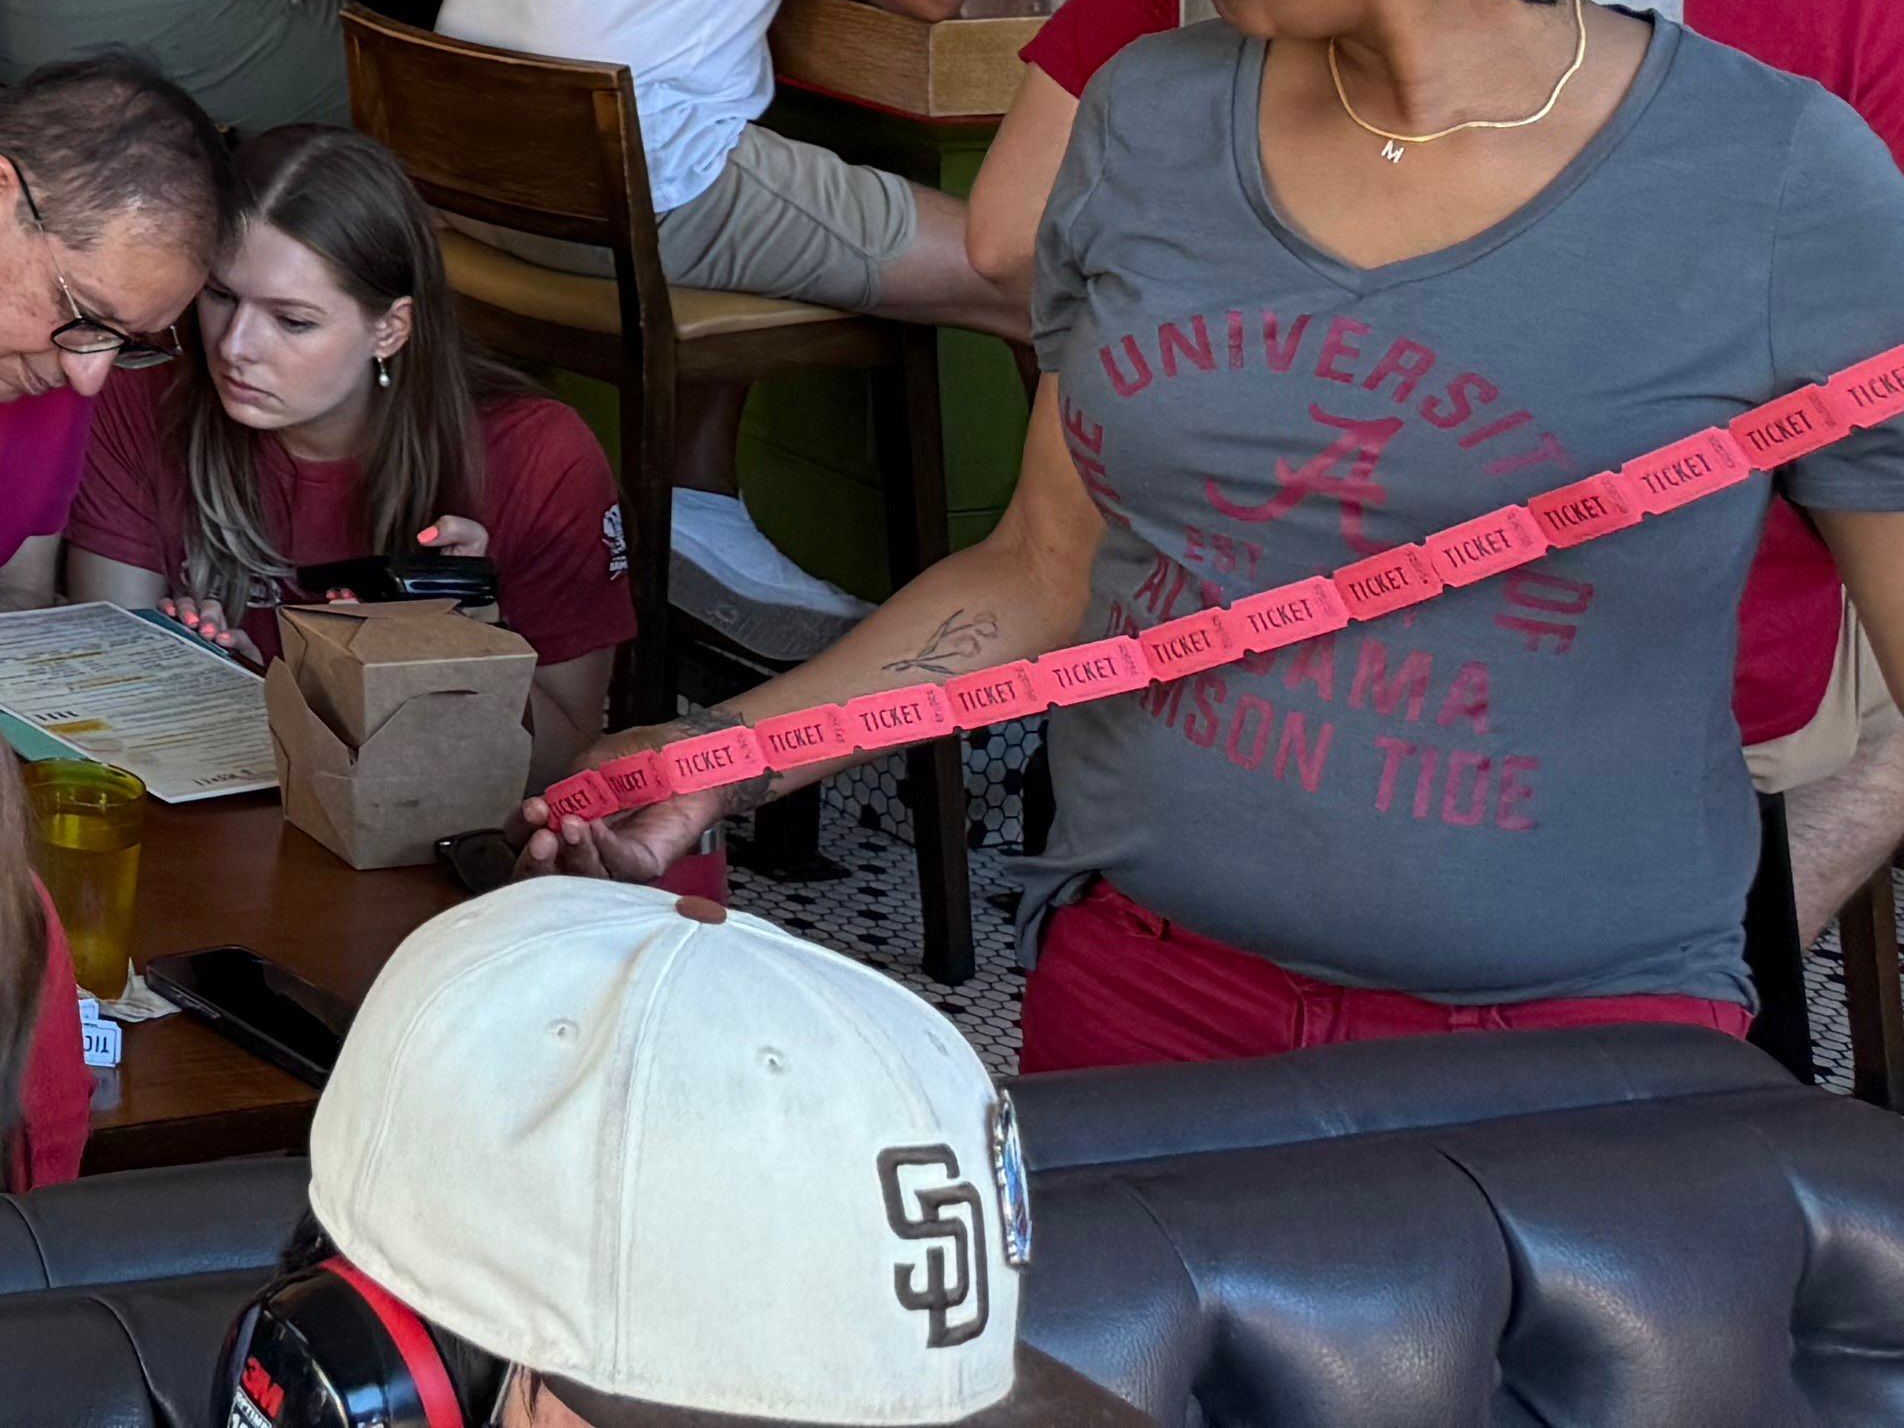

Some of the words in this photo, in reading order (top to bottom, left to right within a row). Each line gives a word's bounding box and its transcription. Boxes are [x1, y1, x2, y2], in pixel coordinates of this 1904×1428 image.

[1099, 310, 1578, 478] UNIVERSIT
[1847, 364, 1904, 408] TICKE
[1745, 409, 1814, 453] TICKET
[1641, 453, 1713, 495] TICKET
[1544, 495, 1608, 531] TICKET
[1443, 528, 1512, 569] TICKET
[1349, 565, 1410, 602] TICKET
[1247, 598, 1314, 634] TICKET
[1493, 570, 1594, 656] OF
[1133, 551, 1493, 735] ALAMA
[1151, 629, 1212, 664] TICKET
[1052, 657, 1120, 689] TICKET
[958, 679, 1017, 711] TICKET
[859, 702, 924, 733] TICKET
[768, 723, 826, 754] TICKET
[674, 745, 734, 777] TICKET
[1373, 734, 1542, 833] TIDE
[84, 1035, 110, 1053] TIC
[875, 1143, 990, 1349] SD
[242, 1355, 285, 1420] 3M
